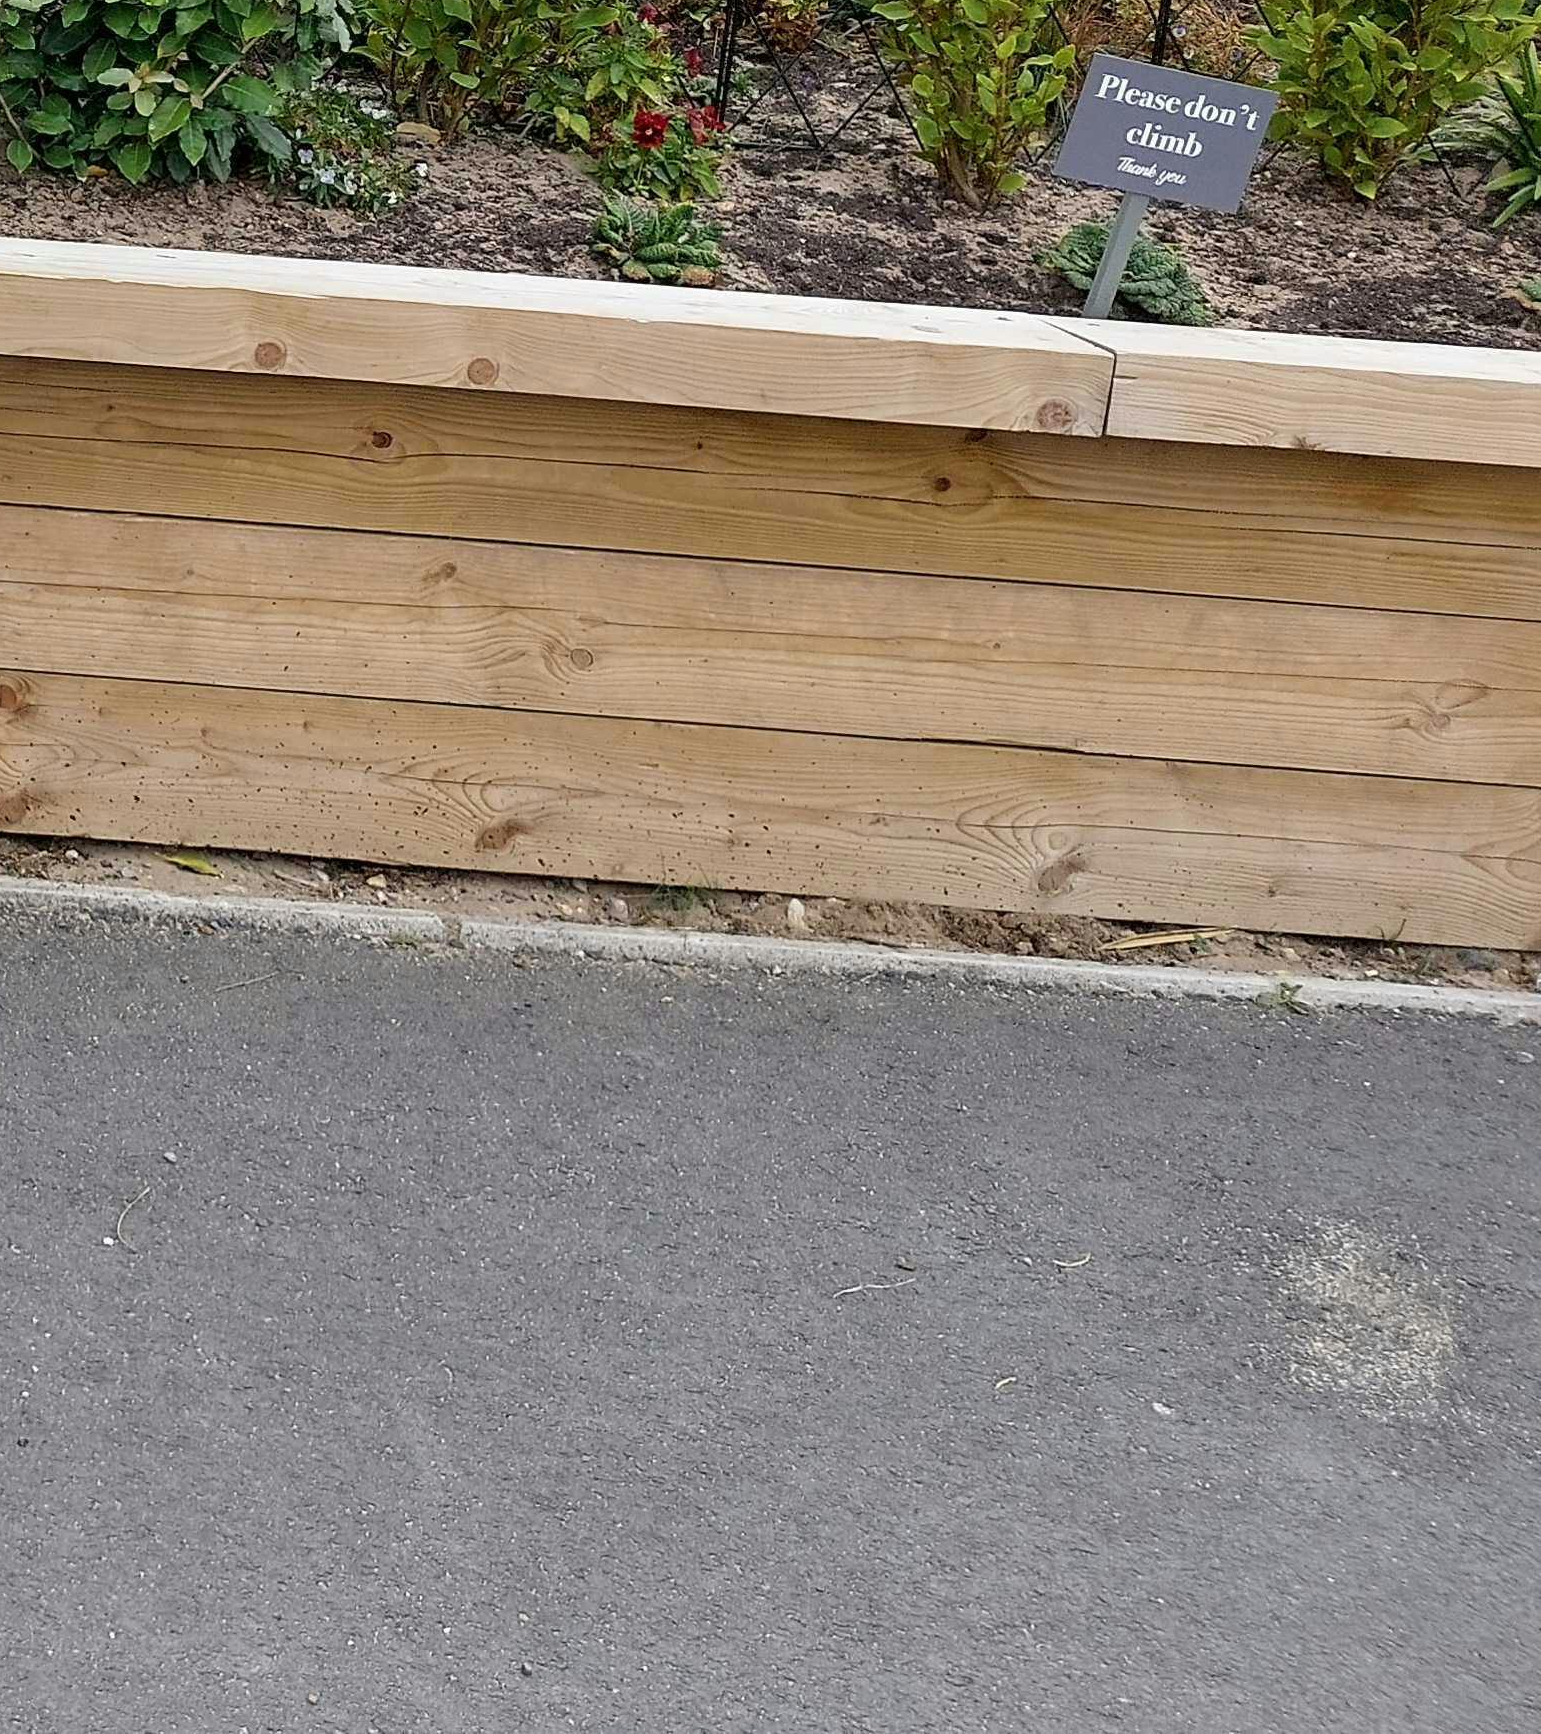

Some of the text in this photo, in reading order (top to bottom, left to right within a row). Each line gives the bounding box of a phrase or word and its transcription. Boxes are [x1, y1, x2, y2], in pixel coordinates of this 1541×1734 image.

[1094, 73, 1261, 132] Please don't
[1125, 122, 1204, 158] climb
[1117, 156, 1188, 186] Thank you
